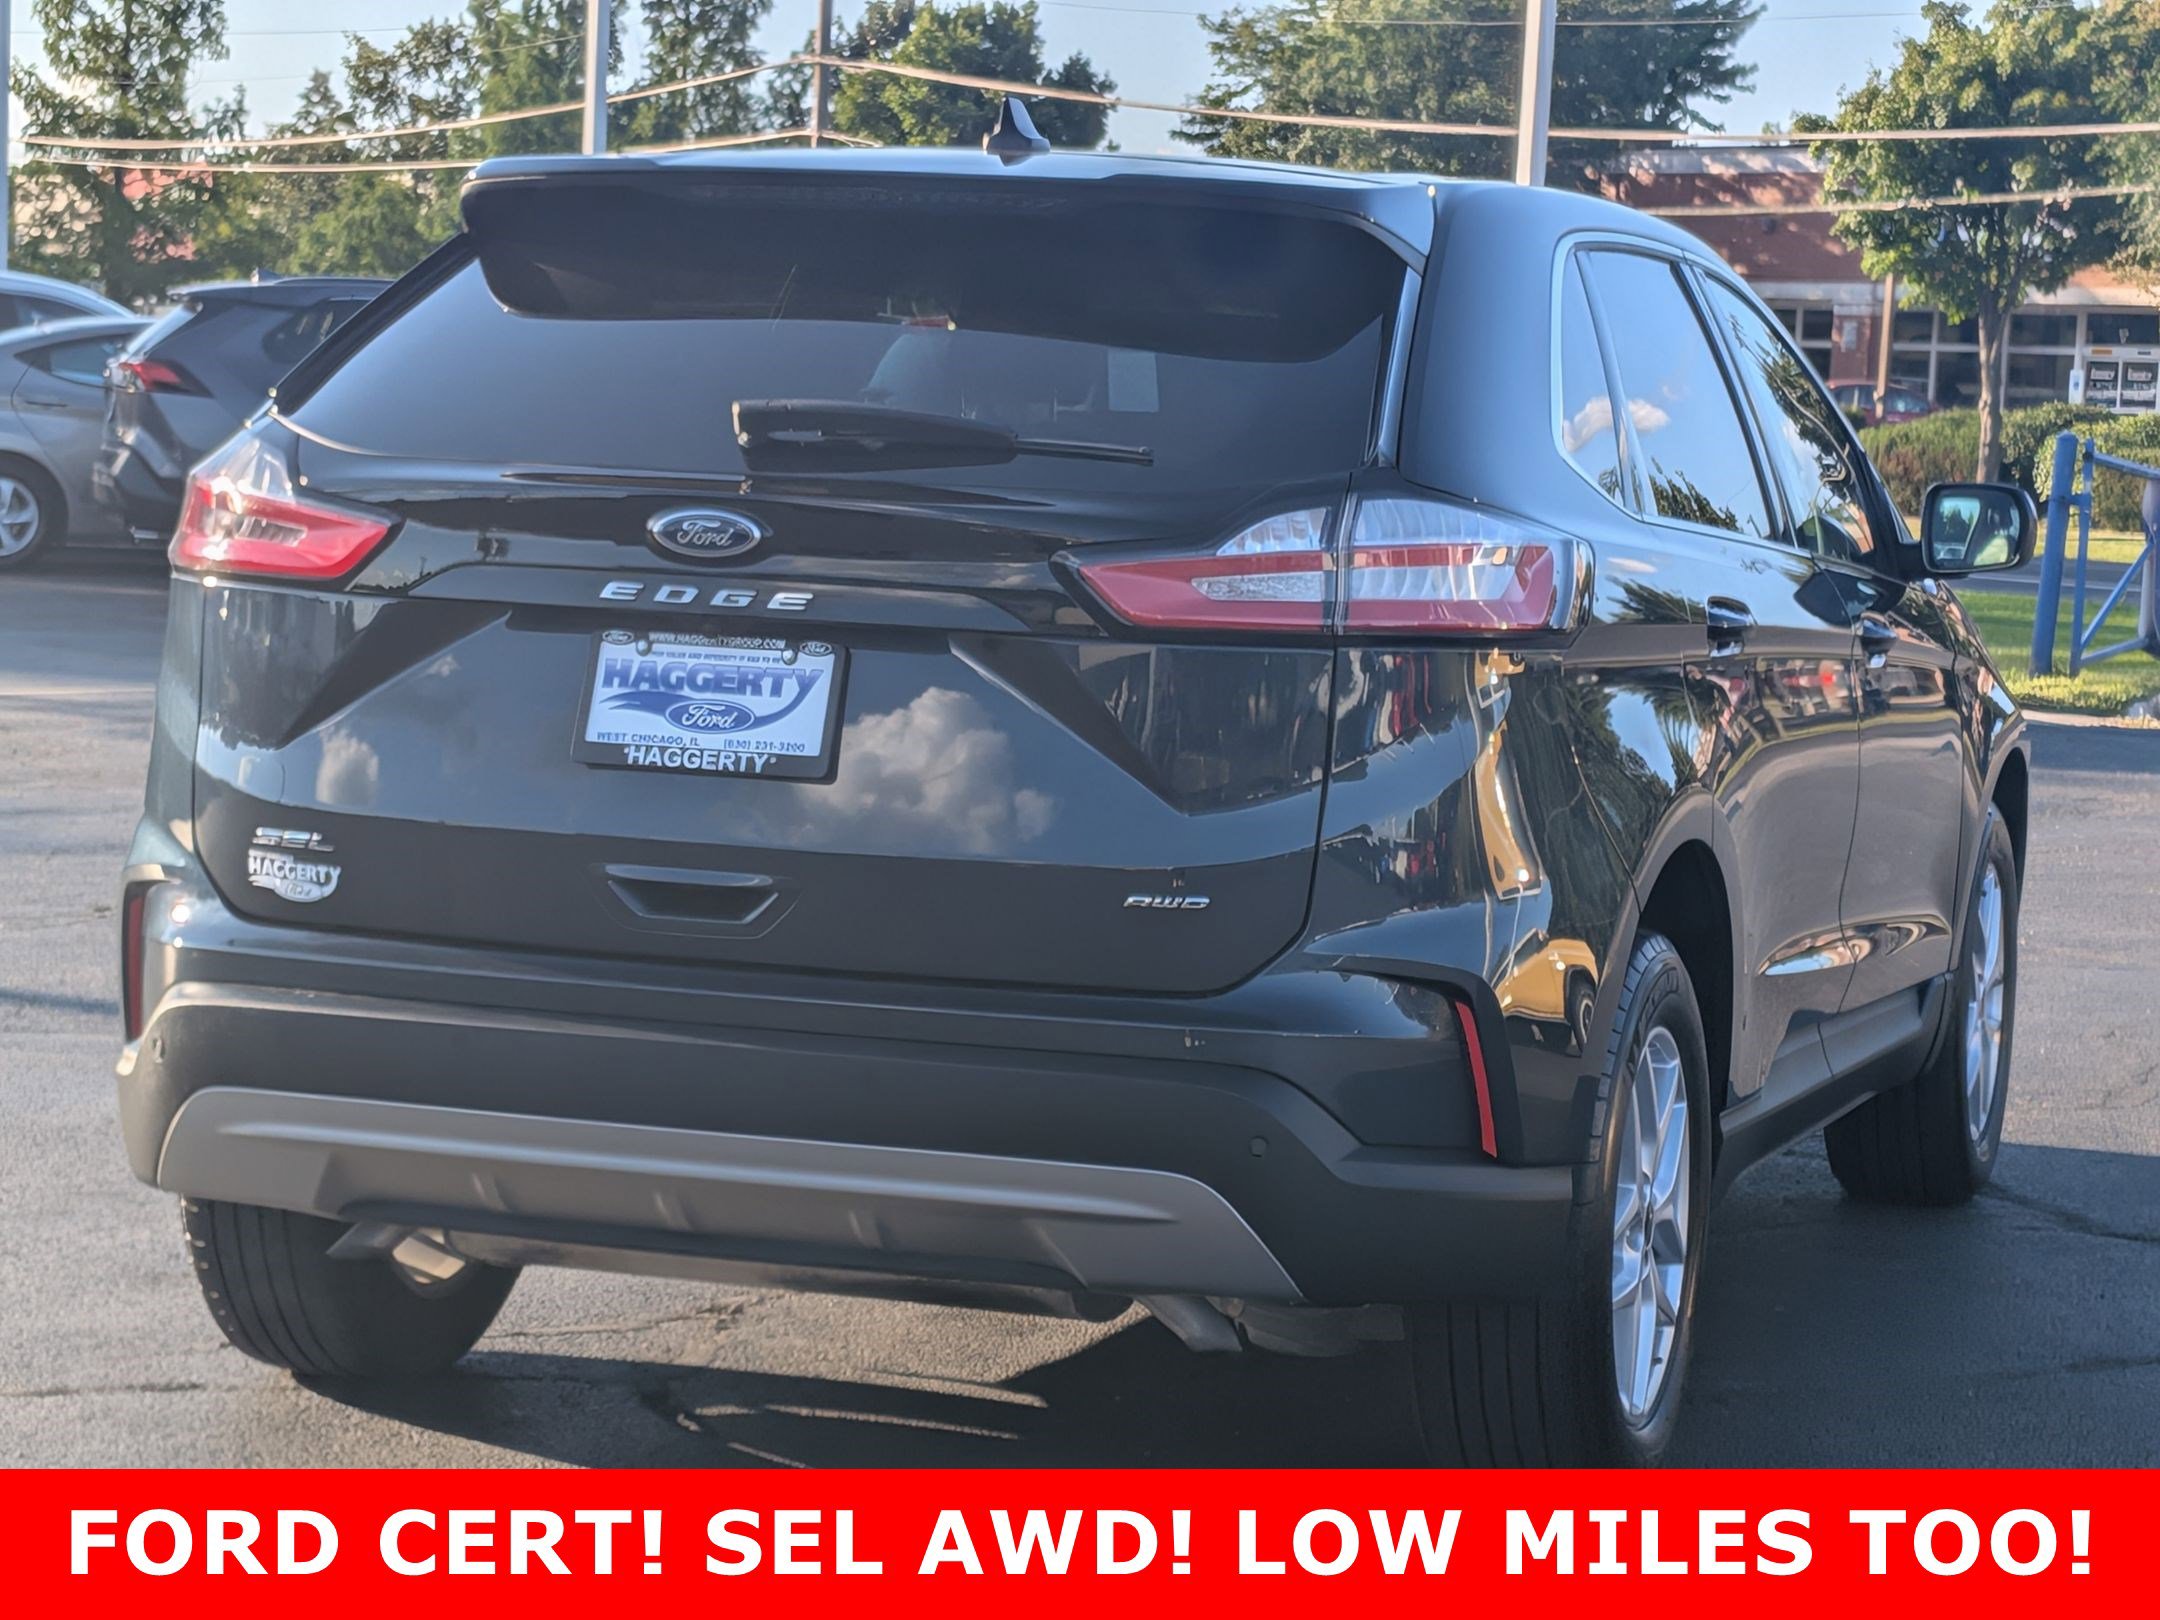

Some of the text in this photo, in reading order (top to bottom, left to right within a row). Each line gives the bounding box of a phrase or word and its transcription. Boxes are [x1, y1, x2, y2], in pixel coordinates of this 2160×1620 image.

[676, 519, 734, 547] Ford
[599, 580, 815, 611] EDGE
[601, 657, 825, 699] HAGGERTY
[681, 704, 737, 729] Ford
[597, 731, 701, 749] WEST CHICAGO, IL
[627, 745, 770, 774] HAGGERTY
[252, 826, 335, 852] SEL
[247, 856, 342, 884] HAGGERTY
[1123, 895, 1210, 909] AWD
